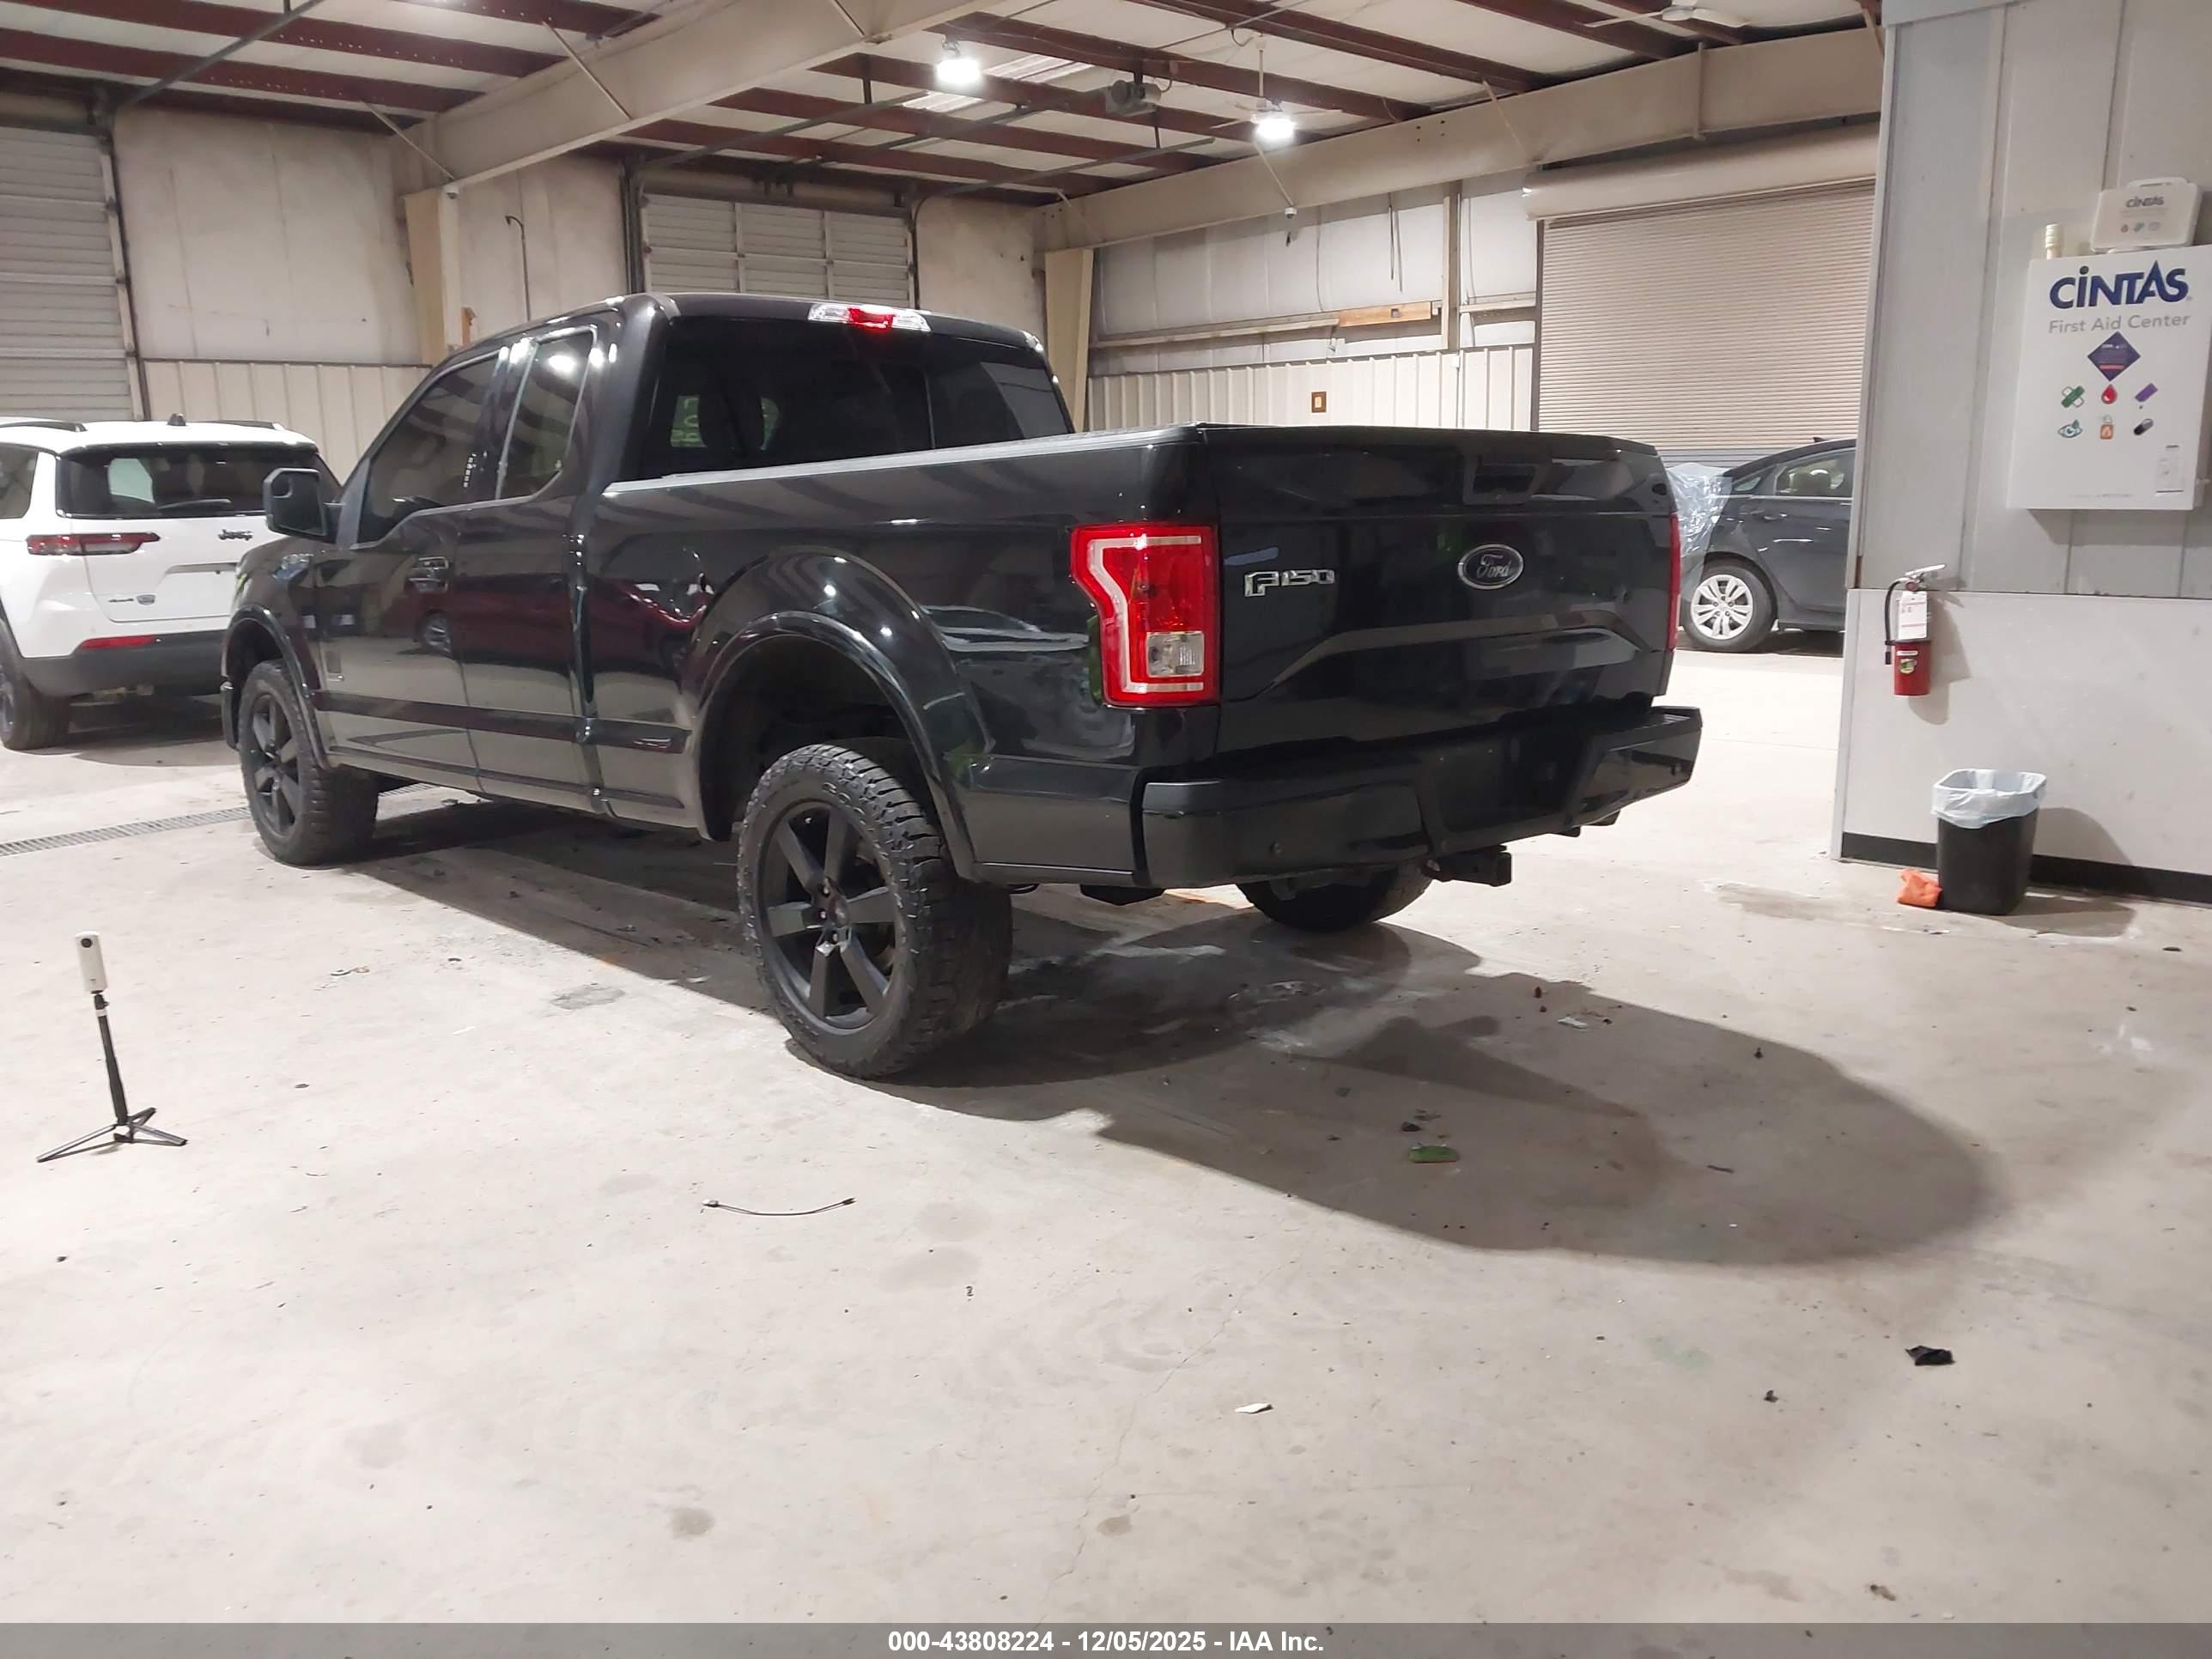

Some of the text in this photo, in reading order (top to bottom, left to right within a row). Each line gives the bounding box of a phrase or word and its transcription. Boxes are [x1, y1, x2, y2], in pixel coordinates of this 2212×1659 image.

[2049, 314, 2191, 334] First Aid Center
[1476, 553, 1512, 578] Ford
